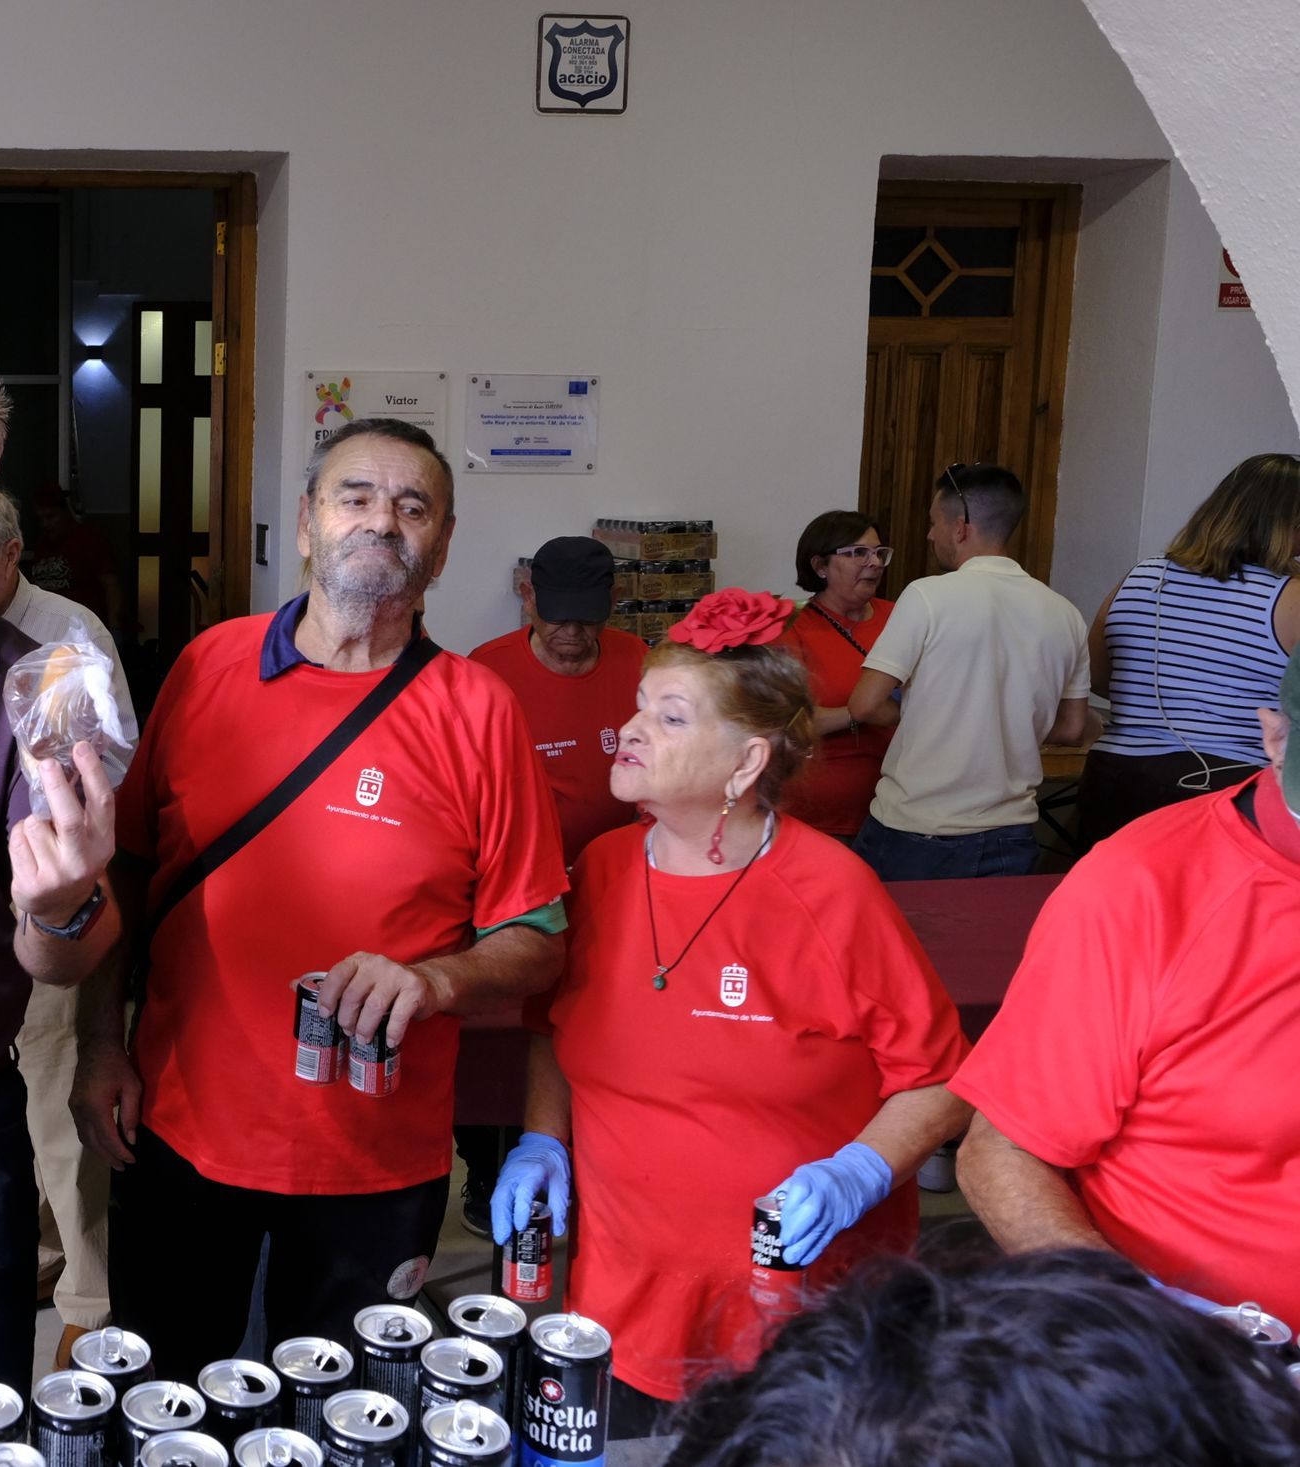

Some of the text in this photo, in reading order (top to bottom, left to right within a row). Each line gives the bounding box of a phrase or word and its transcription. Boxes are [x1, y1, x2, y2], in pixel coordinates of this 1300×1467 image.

[570, 38, 599, 46] ALARMA
[562, 46, 605, 54] CONECTADA
[559, 72, 607, 84] acacio
[386, 395, 418, 405] Viator
[325, 804, 369, 819] Ayuntamiento
[381, 816, 402, 826] Viator
